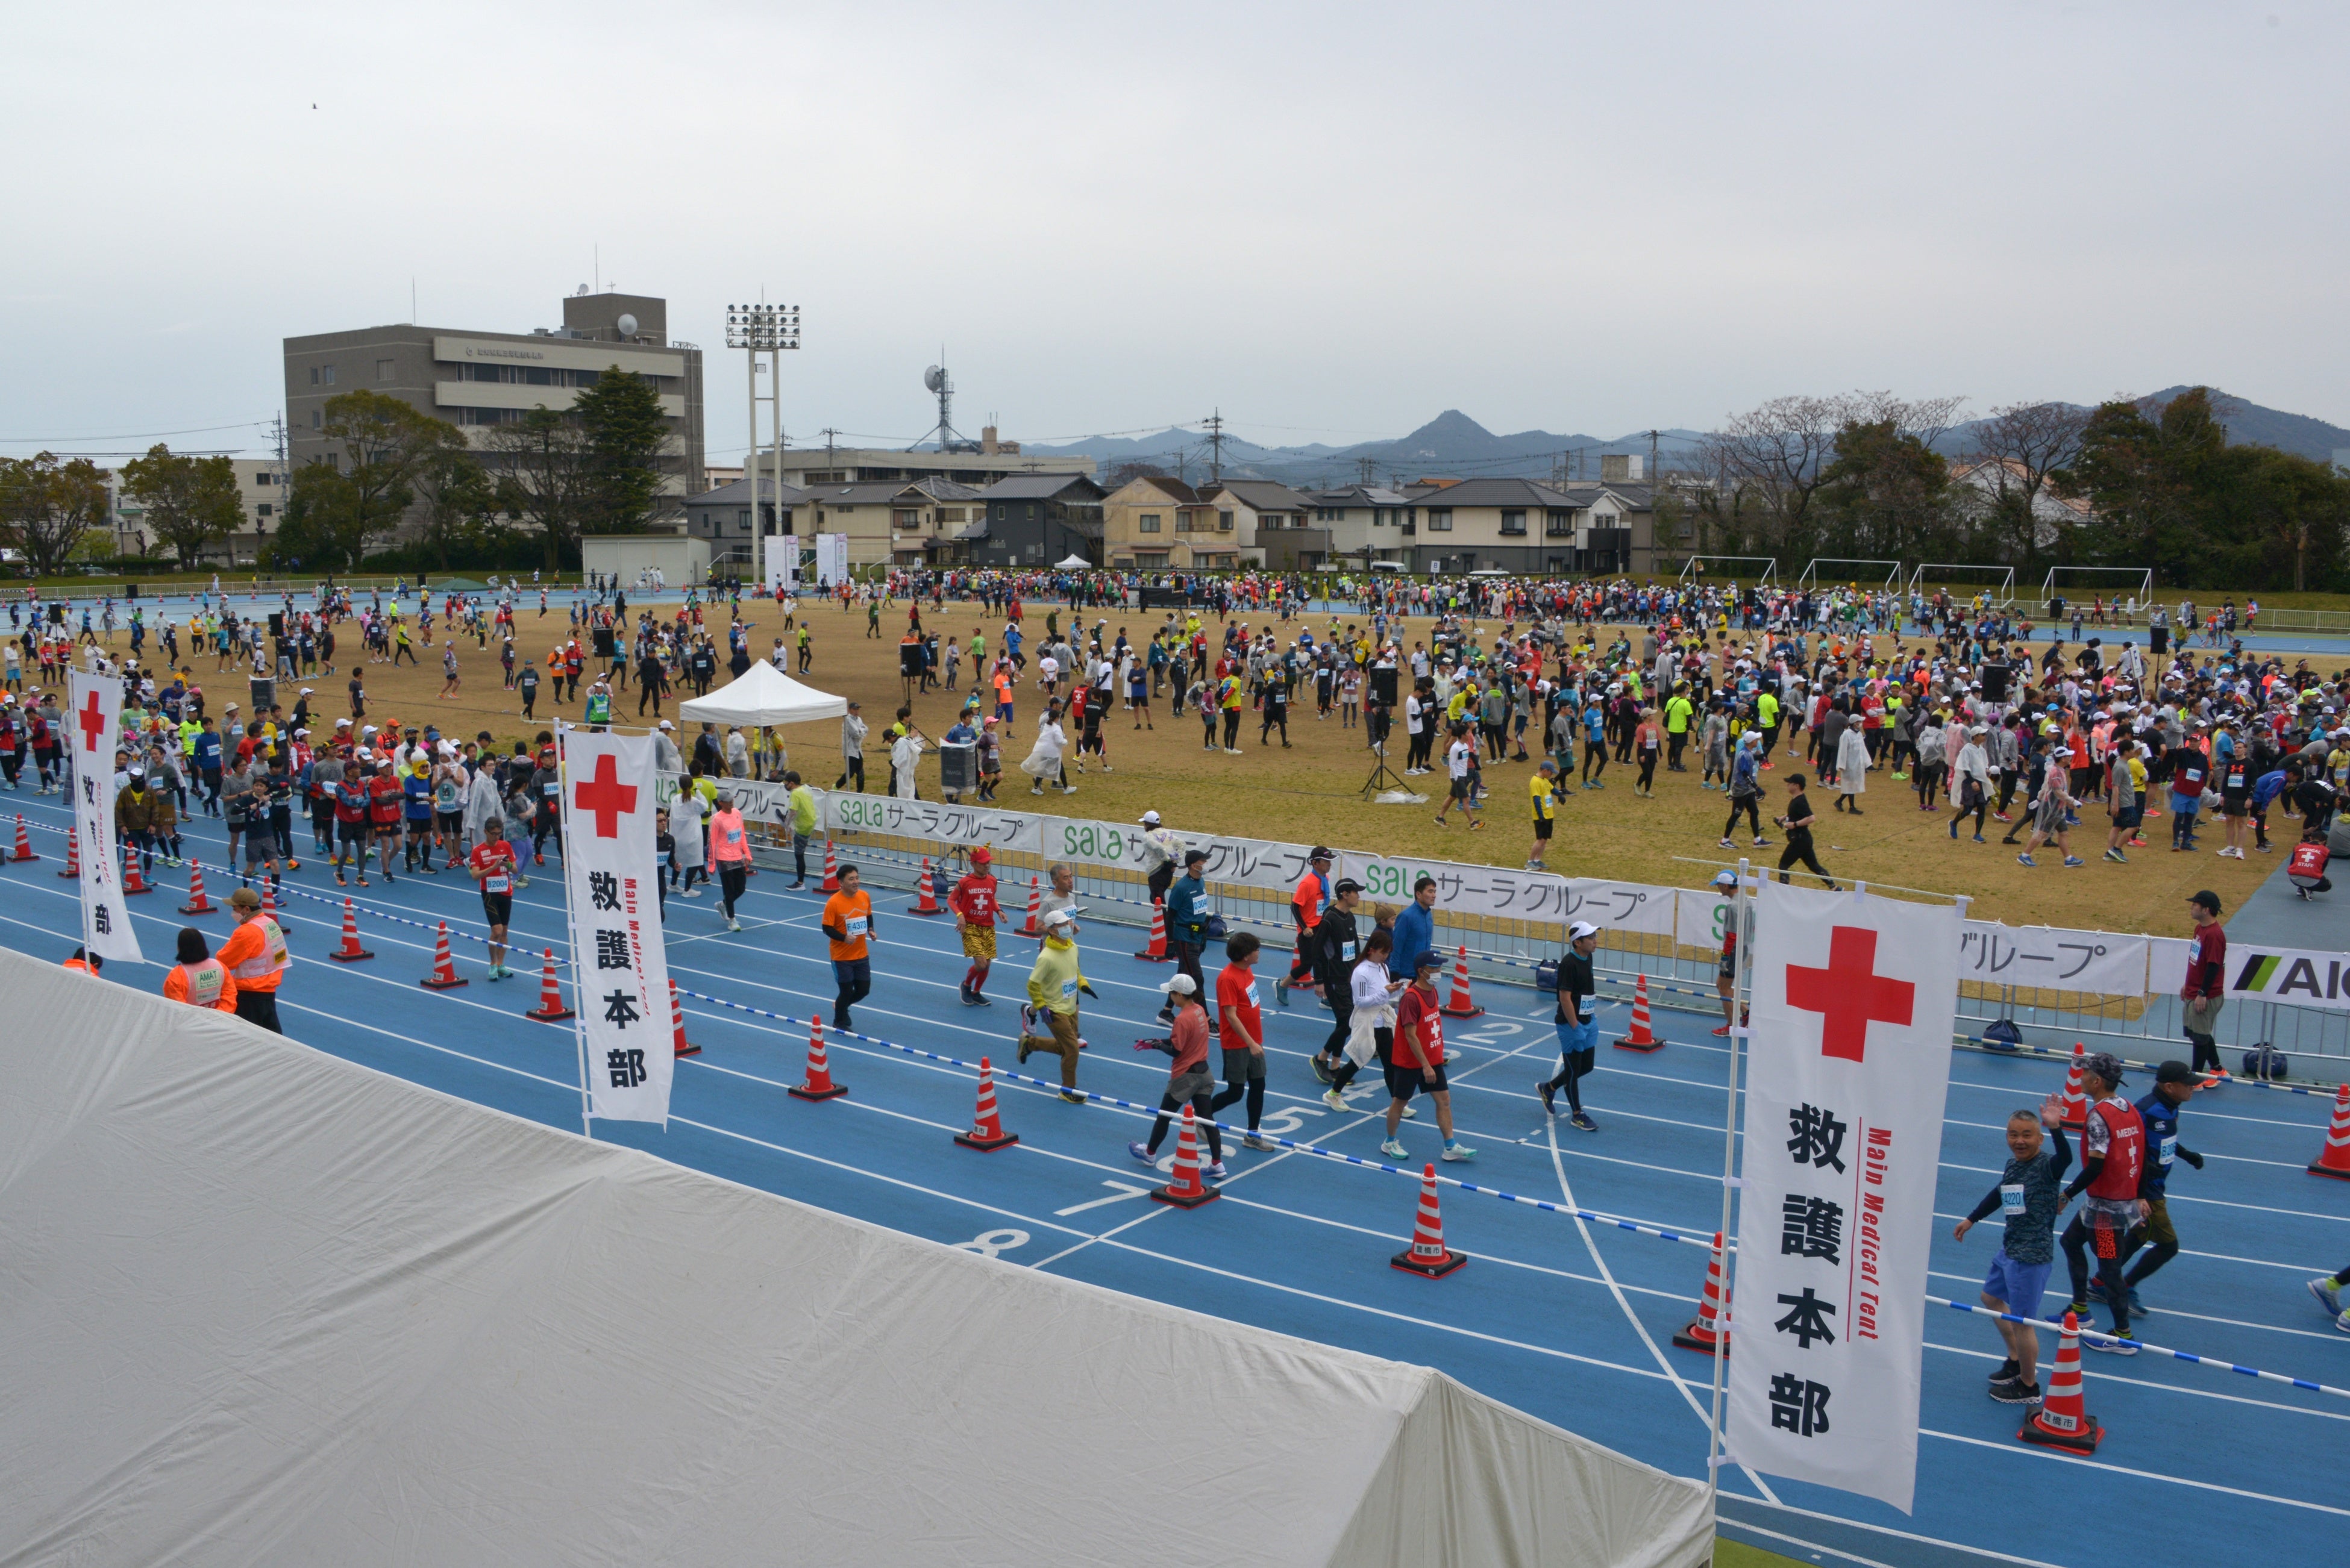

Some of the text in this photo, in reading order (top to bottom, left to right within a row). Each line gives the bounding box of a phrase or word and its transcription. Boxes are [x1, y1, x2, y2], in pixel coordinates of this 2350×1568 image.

[841, 800, 882, 827] sala
[887, 804, 1023, 842] サーラグループ
[1065, 826, 1122, 860] sala
[1438, 872, 1647, 921] サーラグループ
[624, 878, 651, 1017] Main Medical Tent
[199, 970, 217, 981] AMAT
[588, 870, 647, 1089] 救護本部
[1455, 1022, 1524, 1045] 2
[1258, 1107, 1324, 1134] 5
[1057, 1179, 1127, 1216] 7
[952, 1228, 1028, 1258] 8
[1858, 1126, 1891, 1340] Main Medical Tent
[1417, 1245, 1439, 1254] 豊橋市
[1769, 1102, 1847, 1438] 救護本部
[1699, 1317, 1713, 1329] 豊橋
[2043, 1412, 2073, 1428] 豊橋市
